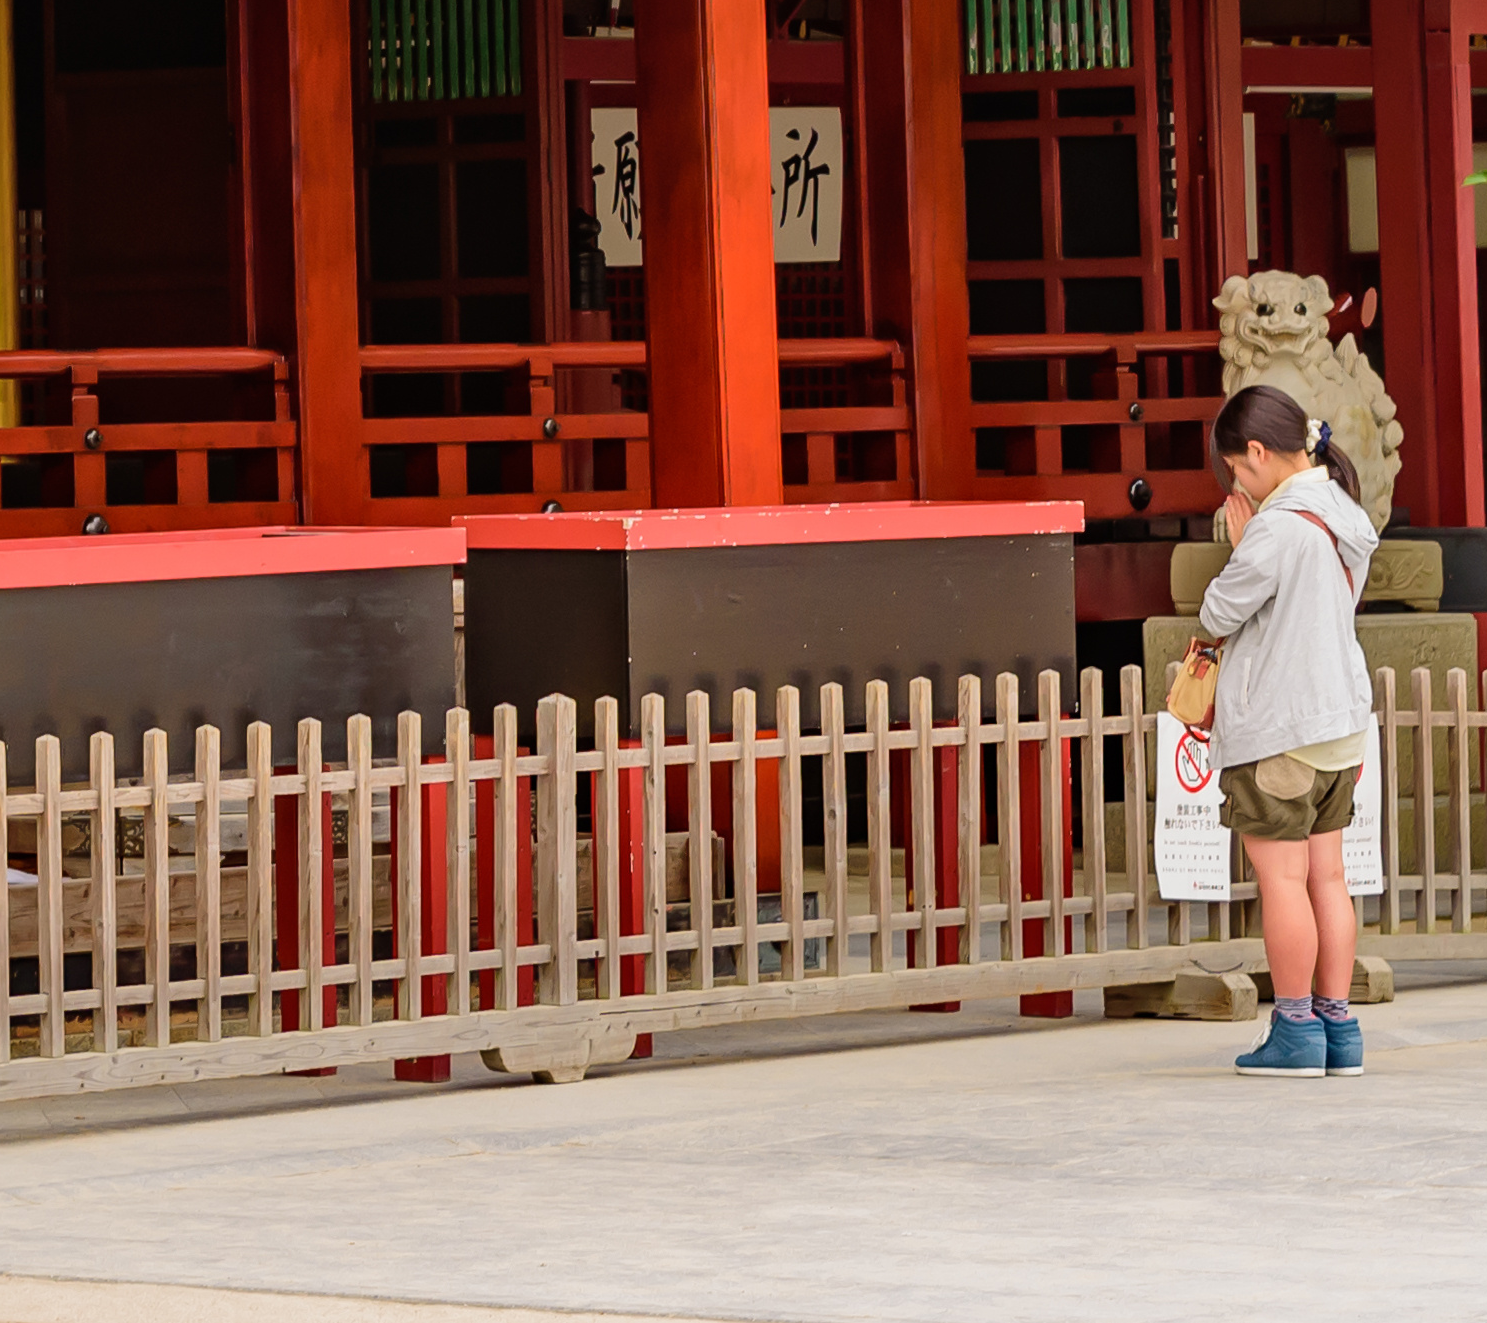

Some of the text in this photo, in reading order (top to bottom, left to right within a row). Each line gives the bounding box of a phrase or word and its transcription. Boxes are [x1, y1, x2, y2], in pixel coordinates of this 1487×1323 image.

[1164, 817, 1222, 831] 触れないで下さい
